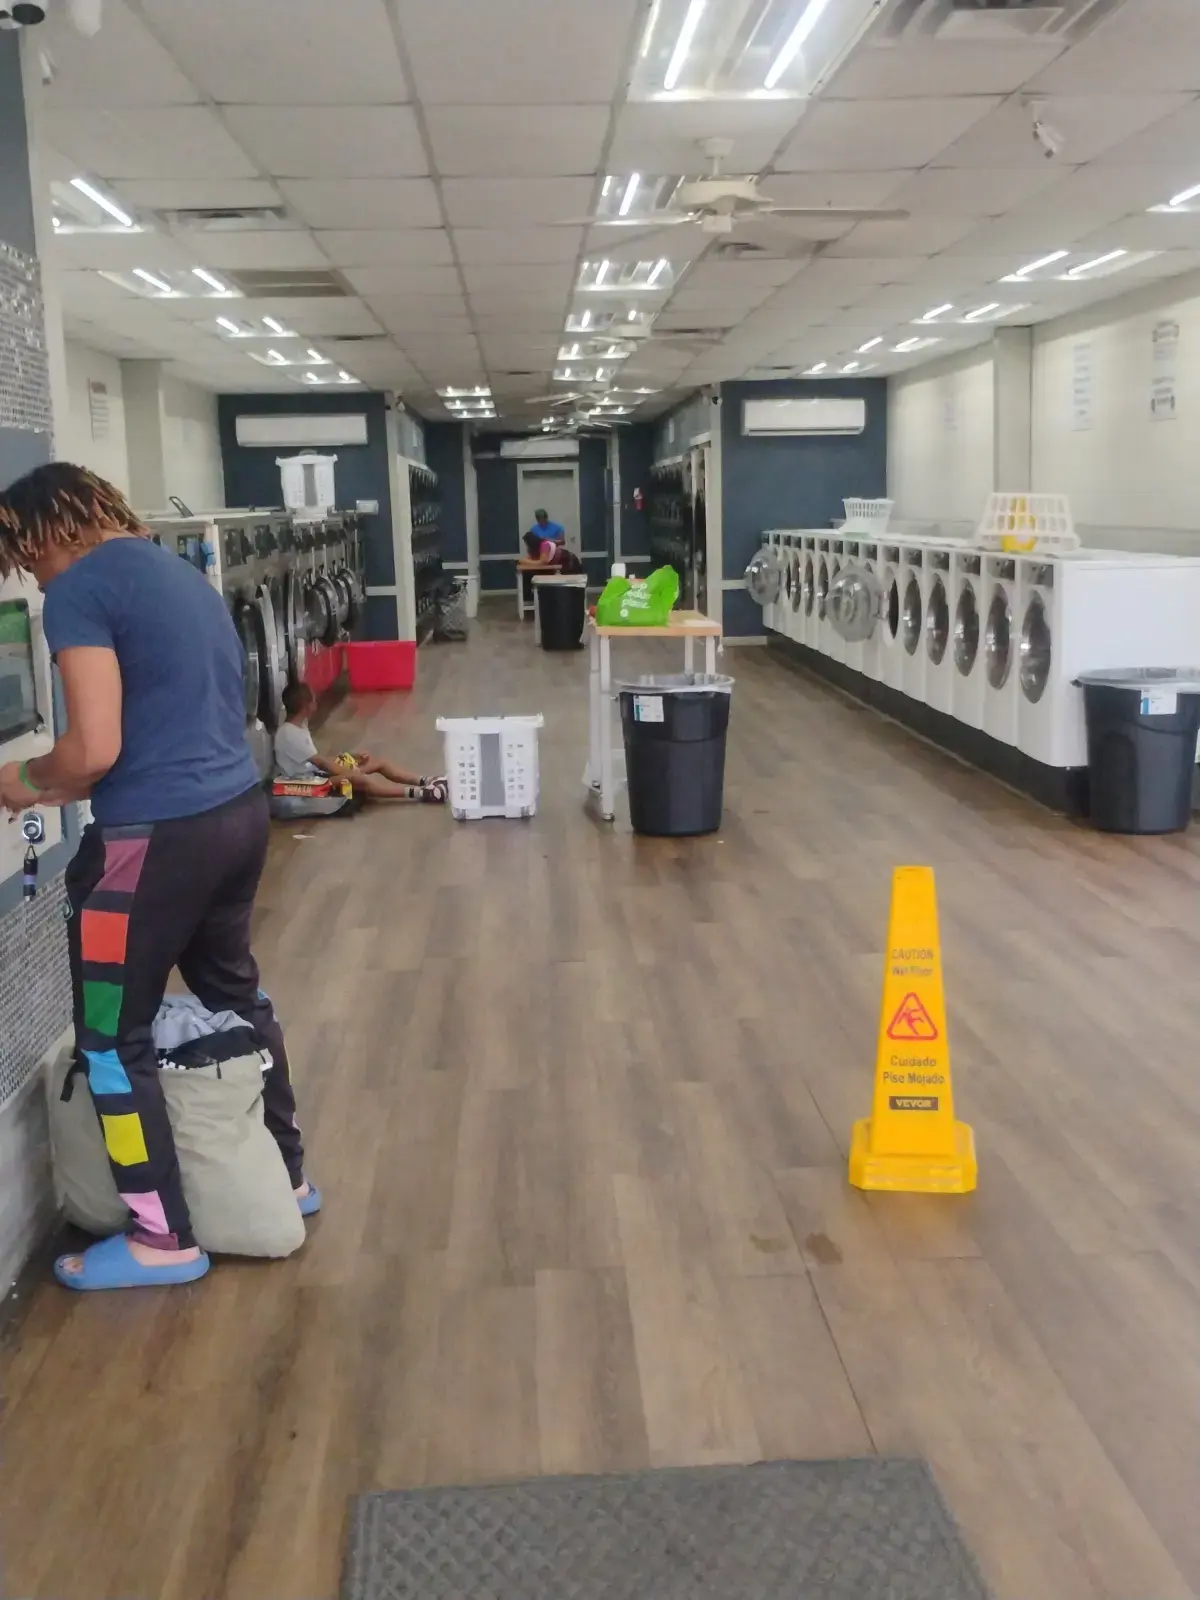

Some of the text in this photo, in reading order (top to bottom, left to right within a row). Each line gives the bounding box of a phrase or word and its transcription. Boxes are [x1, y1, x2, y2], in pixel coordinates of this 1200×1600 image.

[891, 948, 935, 960] CAUTION
[890, 1055, 937, 1067] Cuidado
[907, 1072, 945, 1087] Mojado
[895, 1099, 932, 1108] VEVOR
